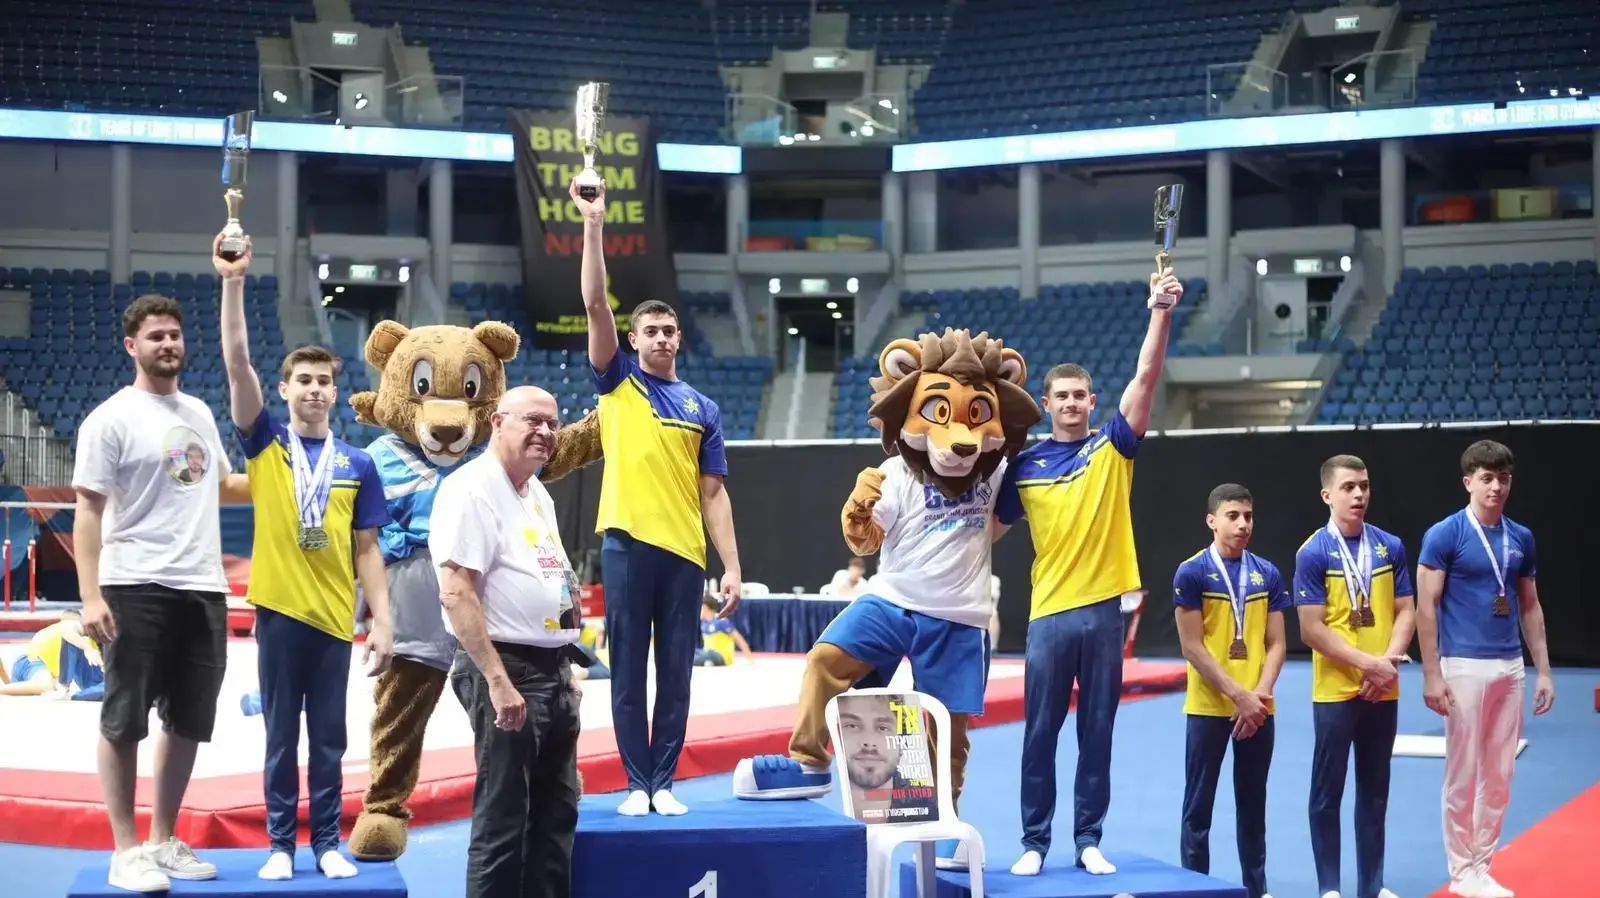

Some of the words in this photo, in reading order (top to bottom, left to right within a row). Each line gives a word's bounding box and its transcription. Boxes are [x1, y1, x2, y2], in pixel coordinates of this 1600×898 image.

[530, 126, 639, 156] BRING
[537, 162, 636, 190] THM
[888, 701, 921, 734] אל
[689, 870, 717, 898] 1
